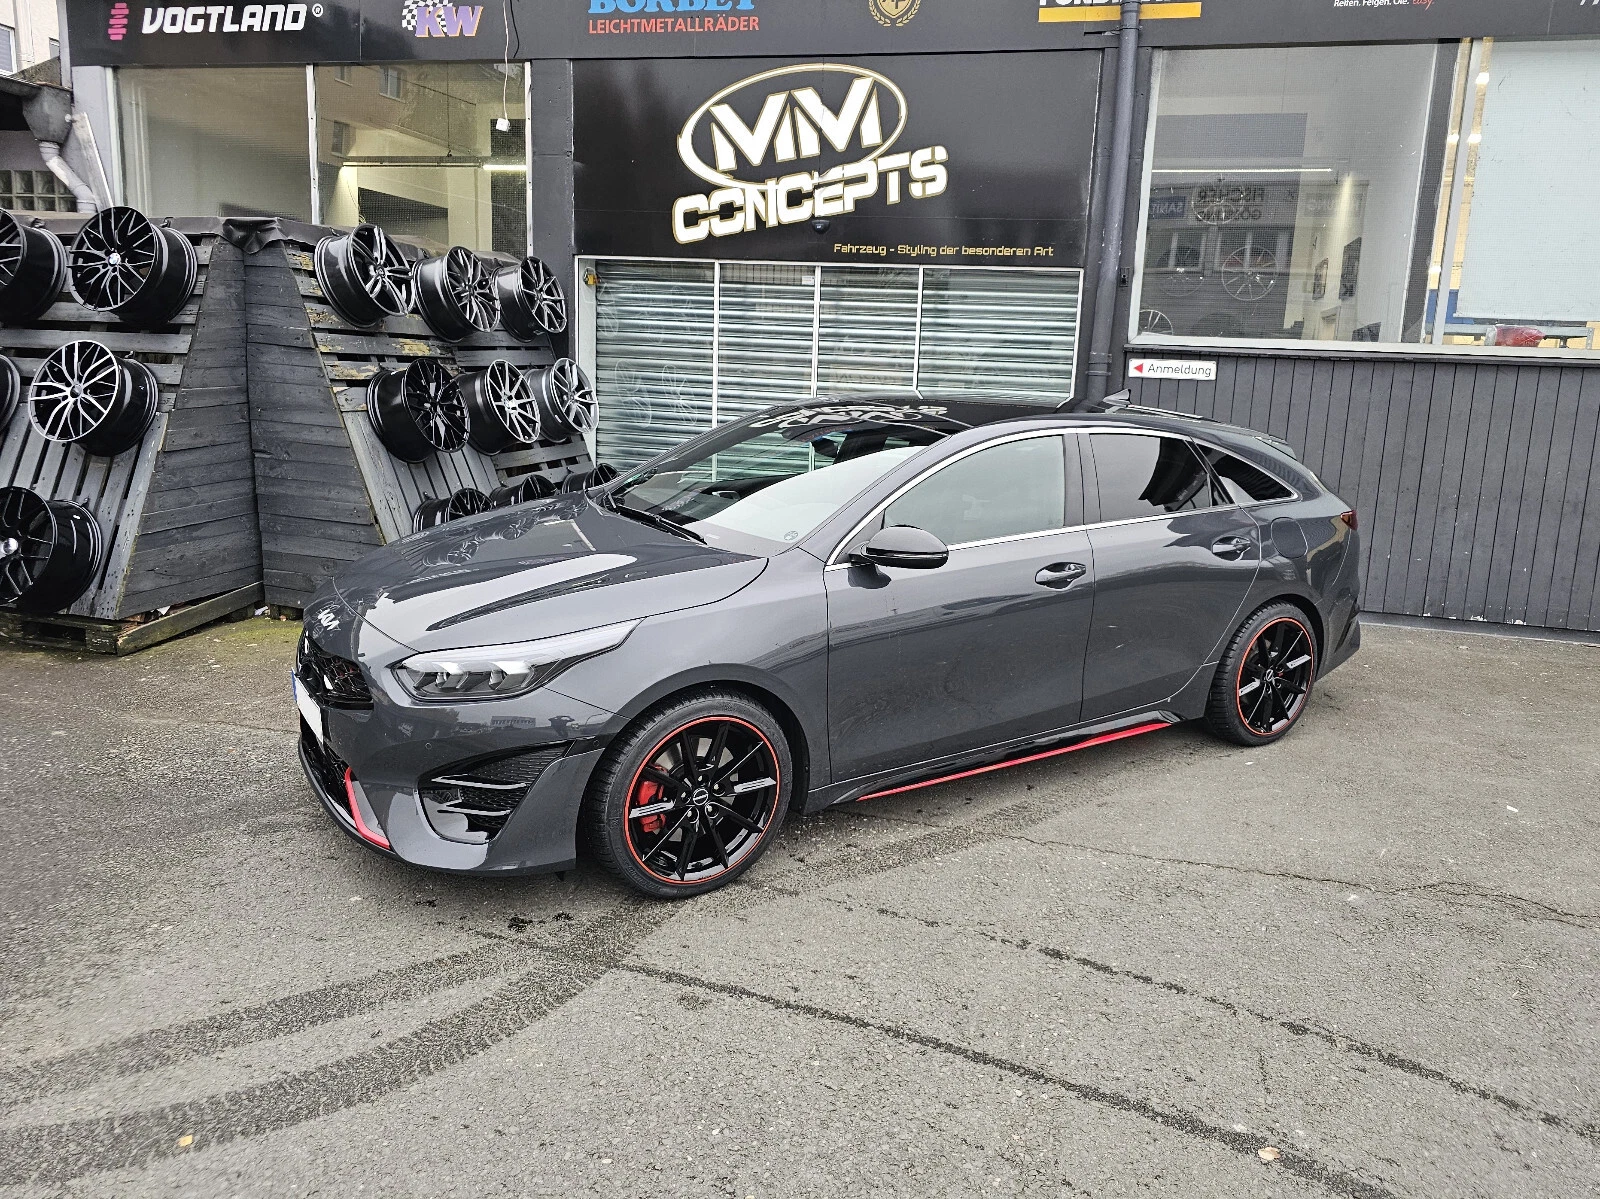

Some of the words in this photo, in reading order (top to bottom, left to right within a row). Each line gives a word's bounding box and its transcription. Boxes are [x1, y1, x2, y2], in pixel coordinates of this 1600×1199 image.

[142, 3, 307, 34] VOGTLAND
[416, 5, 484, 38] KW
[589, 14, 759, 34] LEICHTMETALLRÄDER
[708, 76, 883, 172] MM
[671, 145, 949, 244] CONCEPTS
[834, 243, 887, 256] Fahrzeug
[897, 244, 937, 257] Styling
[939, 245, 960, 255] der
[961, 245, 1031, 256] besonderen
[1033, 246, 1054, 257] Art
[1147, 364, 1212, 378] Anmeldung
